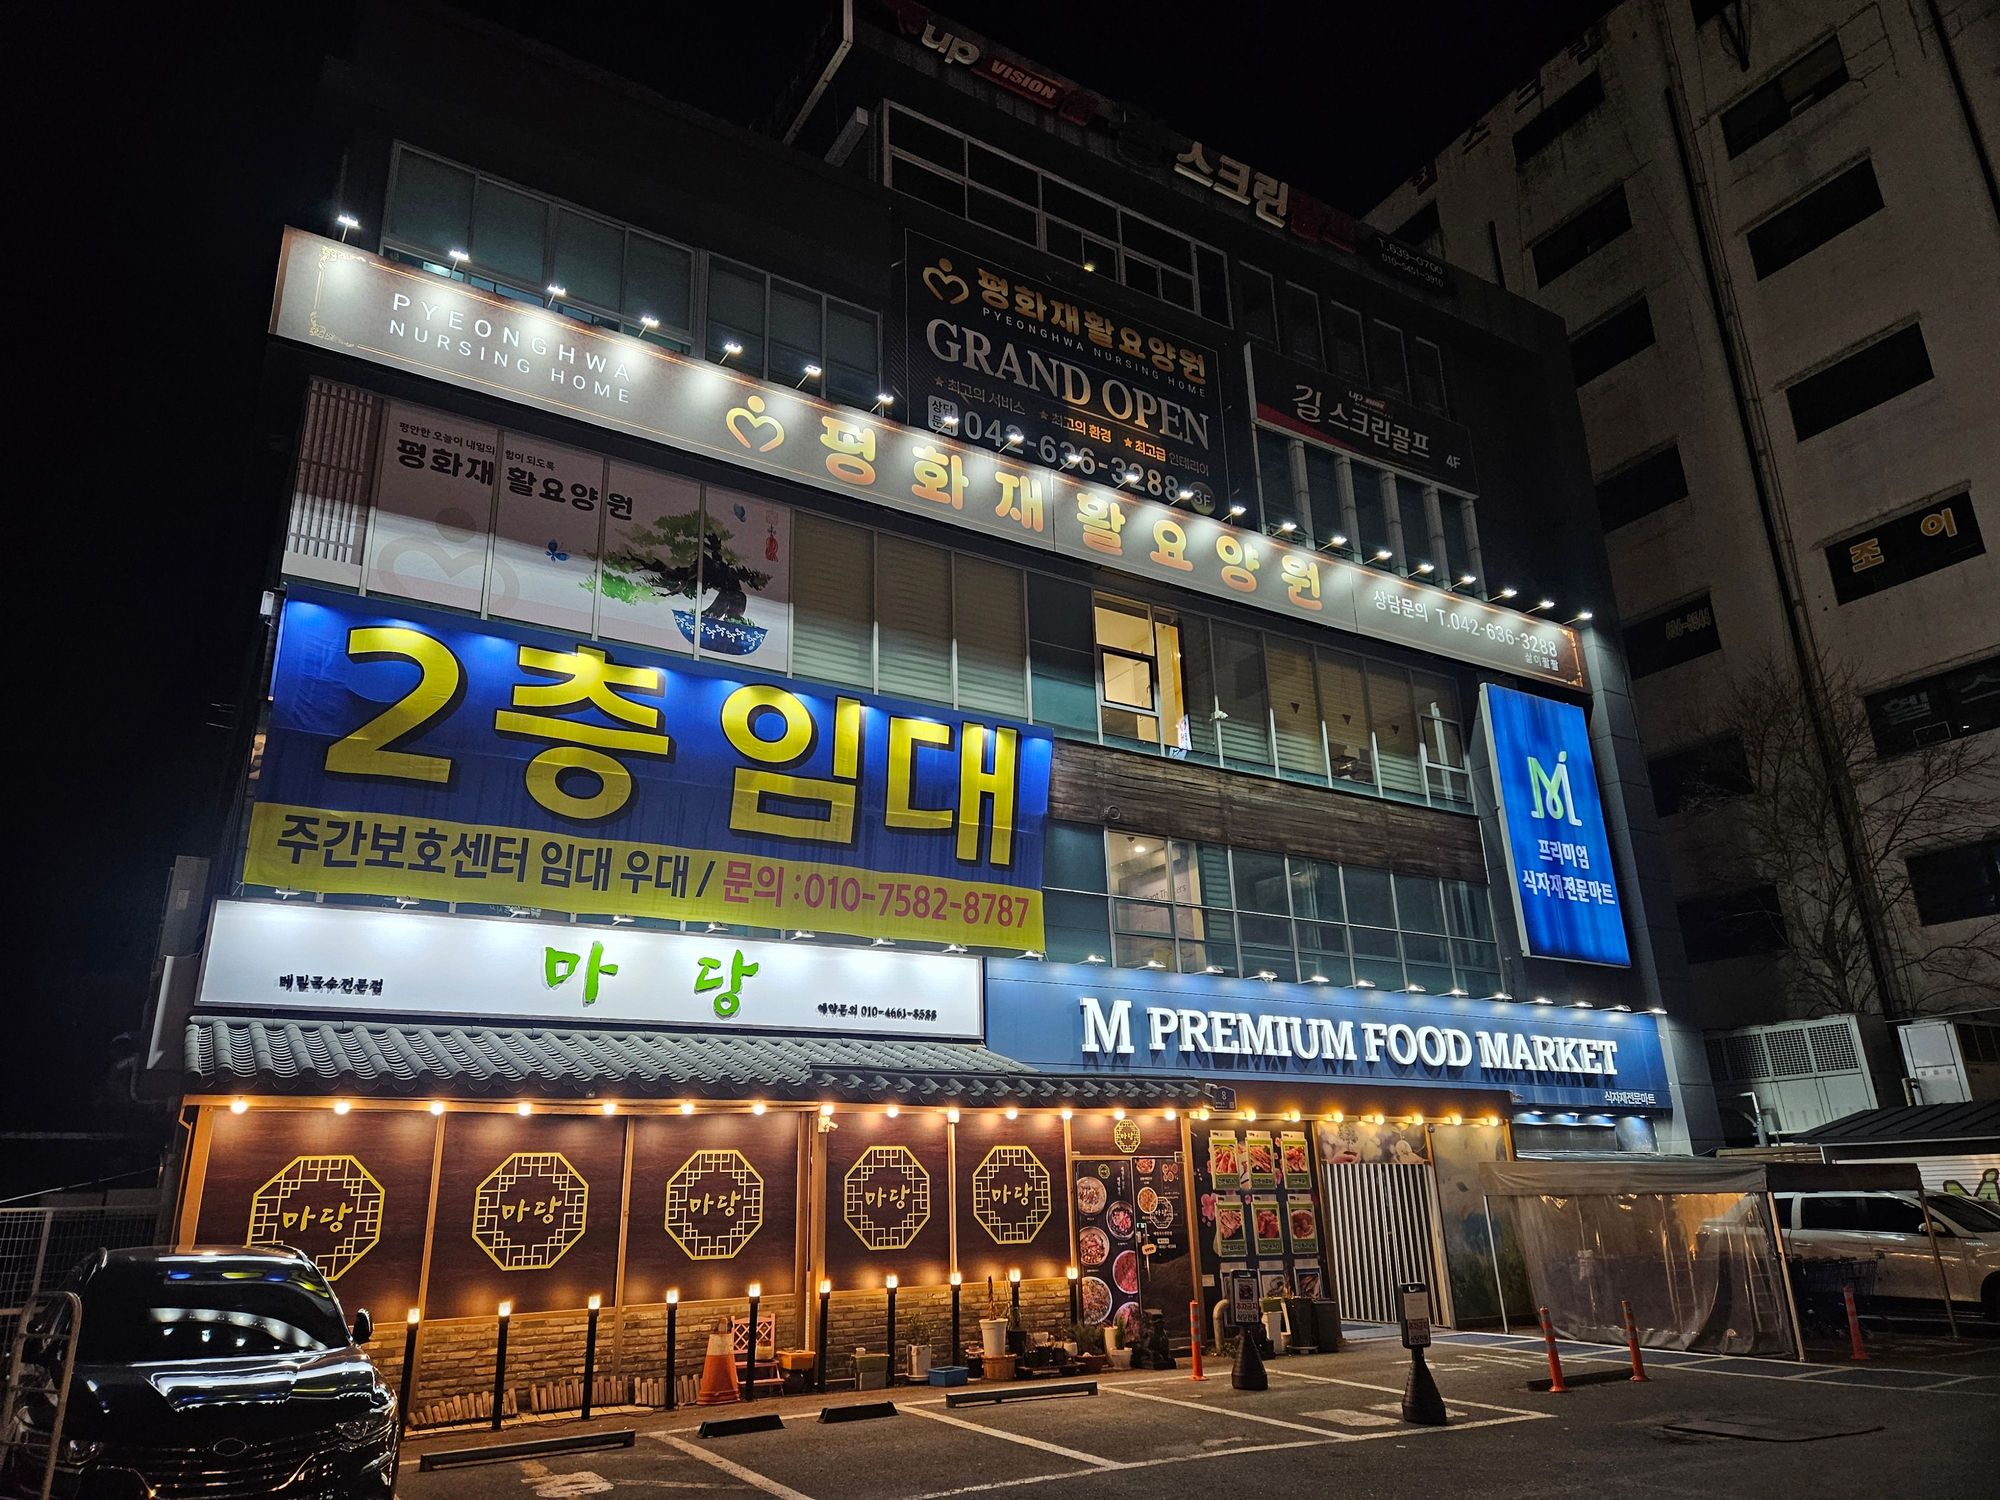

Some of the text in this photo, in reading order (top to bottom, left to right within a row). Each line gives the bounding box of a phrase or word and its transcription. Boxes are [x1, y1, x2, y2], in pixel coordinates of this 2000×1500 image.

[920, 22, 980, 65] up
[990, 58, 1057, 100] VISION
[1173, 141, 1289, 229] 스크린
[392, 292, 632, 382] PYEONGHWA
[977, 267, 1207, 385] 평화재활요양원
[388, 319, 631, 404] NURSING HOME
[983, 307, 1206, 398] PYEONGHWA NURSING HOME
[926, 318, 1209, 450] GRAND OPEN
[947, 379, 1026, 415] 최고의 서비스
[1051, 413, 1112, 443] 최고의 환경
[1292, 384, 1430, 458] 길 스크린골프
[399, 422, 555, 471] 평안한 오늘이 내일의 힘이 되도록
[964, 410, 1180, 502] 042-636-3288
[1135, 440, 1209, 477] 최고급 인테리어
[1446, 454, 1462, 469] 4F
[819, 414, 1323, 611] 평화재활요양원
[1373, 590, 1558, 658] 상담문의 T.042-636-3288
[324, 626, 1019, 866] 2층 임대
[277, 814, 525, 883] 주간보호센터
[540, 840, 611, 892] 임대
[621, 847, 688, 899] 우대
[722, 861, 783, 909] 문의
[1538, 838, 1590, 870] 프리미엄
[1522, 869, 1616, 905] 식자재전문마트
[544, 940, 760, 1019] 마당
[1080, 997, 1619, 1075] M PREMIUM FOOD MARKET
[1604, 1091, 1657, 1105] 식자재전문마트
[282, 1202, 354, 1233] 마당
[502, 1196, 563, 1224] 마당
[689, 1189, 742, 1217] 마당
[864, 1184, 911, 1210] 마당
[991, 1182, 1034, 1206] 마당
